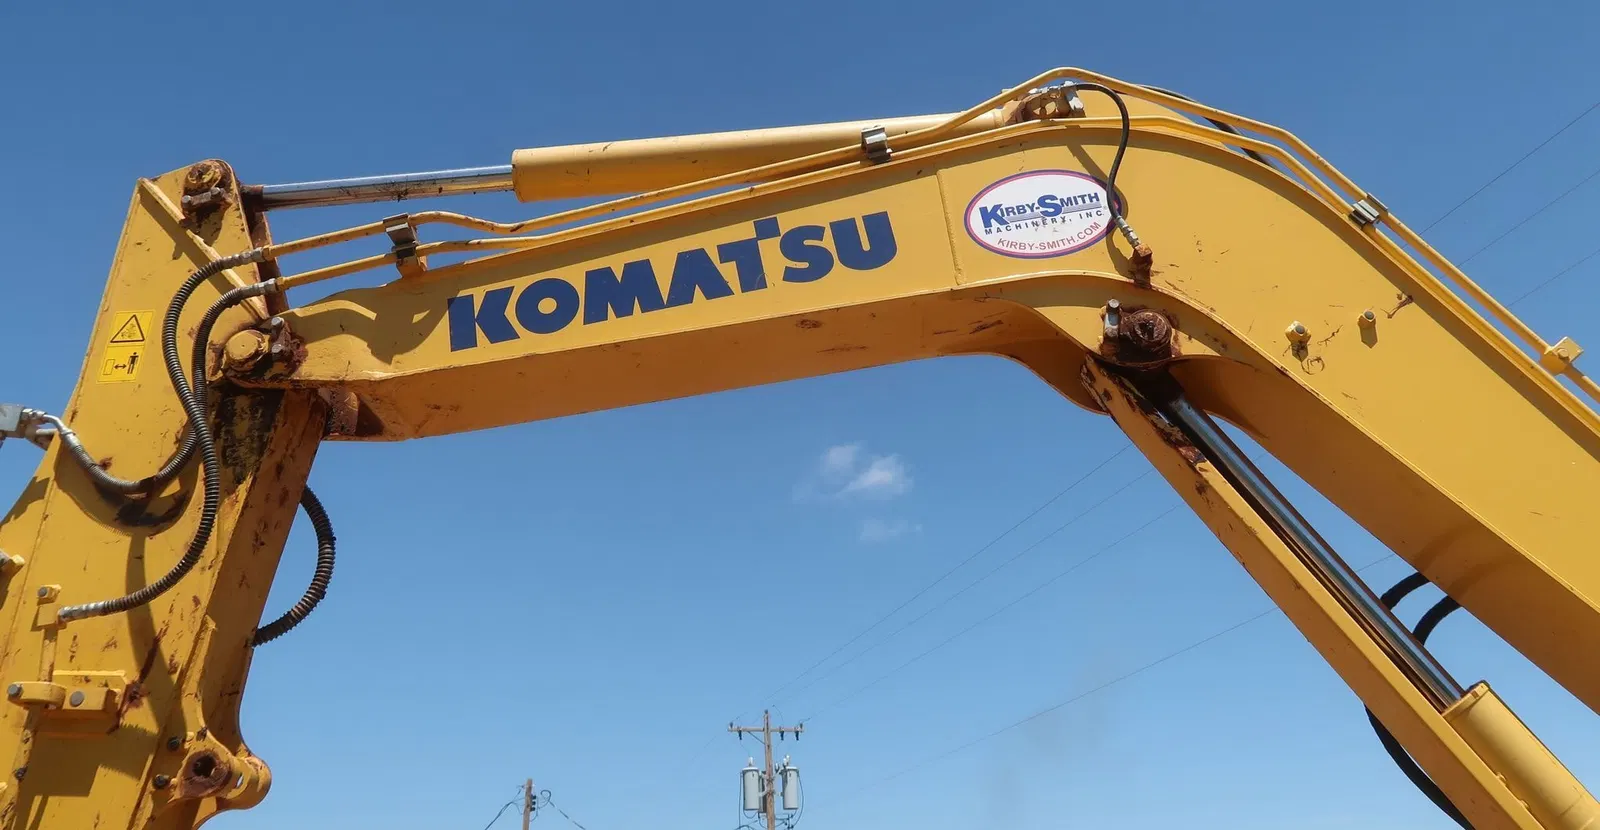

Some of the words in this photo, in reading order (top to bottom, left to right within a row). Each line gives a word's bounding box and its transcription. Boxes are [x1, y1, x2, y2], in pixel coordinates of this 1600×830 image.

[979, 192, 1100, 228] KIRBY-SMITH
[997, 221, 1102, 251] KIRBY-SMITH.COM
[447, 211, 898, 352] KOMATSU
